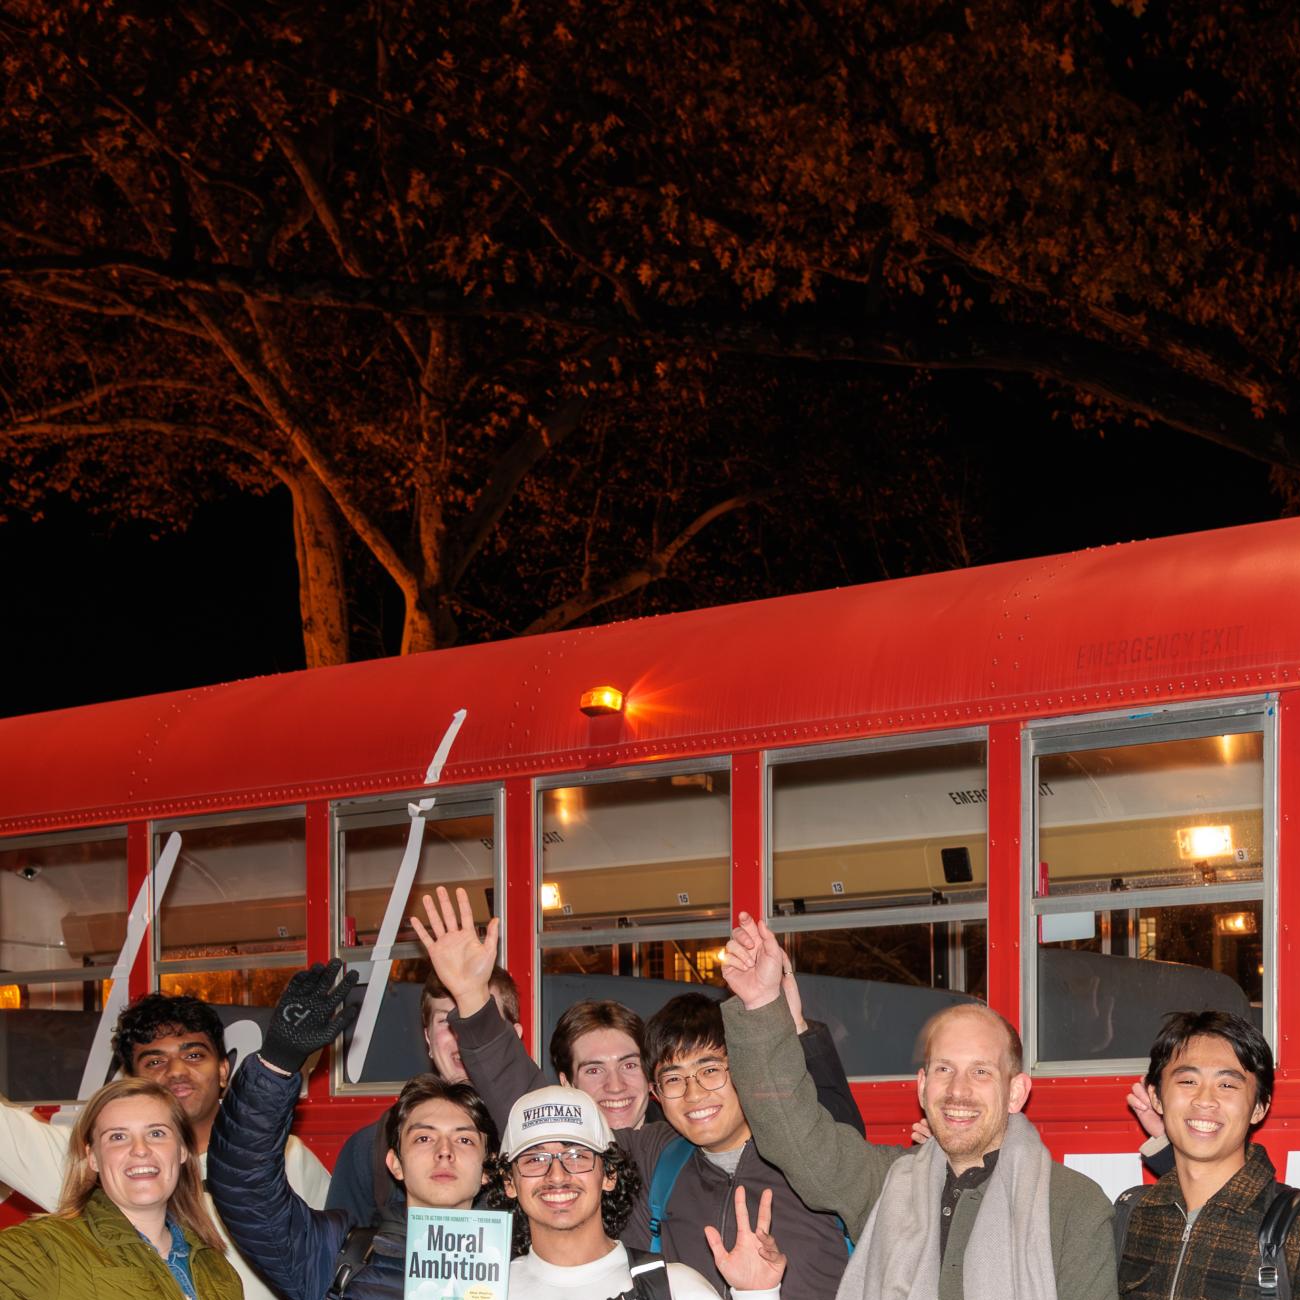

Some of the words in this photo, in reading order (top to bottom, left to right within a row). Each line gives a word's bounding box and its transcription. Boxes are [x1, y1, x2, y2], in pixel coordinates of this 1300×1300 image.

[1076, 631, 1194, 670] EMERGENCY
[1202, 625, 1245, 656] EXIT
[948, 788, 988, 805] EMERG
[1237, 850, 1244, 860] 9
[523, 1105, 582, 1121] WHITMAN
[427, 1224, 484, 1253] Moral
[409, 1252, 500, 1282] Ambition
